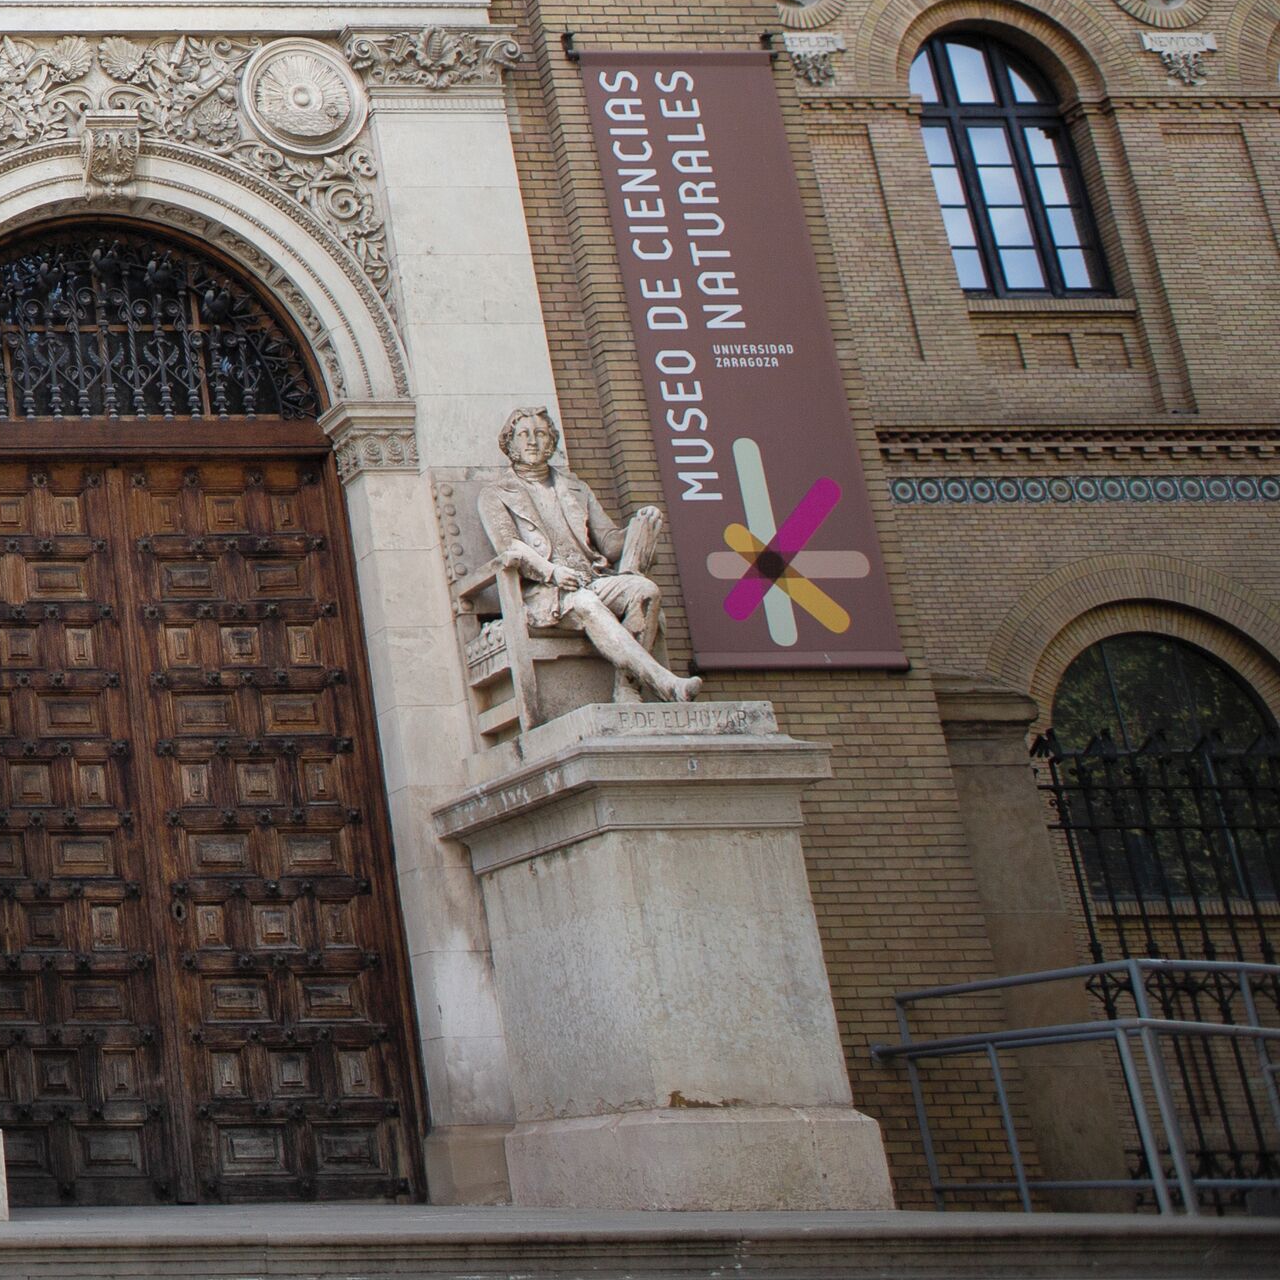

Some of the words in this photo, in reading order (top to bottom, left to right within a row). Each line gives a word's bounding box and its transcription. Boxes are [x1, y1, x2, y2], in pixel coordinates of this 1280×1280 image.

[1150, 35, 1206, 48] NEWTON
[598, 70, 674, 261] CIENCIAS
[654, 70, 747, 329] NATURALES
[640, 278, 689, 330] DE
[712, 343, 794, 354] UNIVERSIDAD
[714, 357, 779, 368] ZARAGOZA
[655, 348, 724, 502] MUSEO
[635, 711, 657, 728] DE
